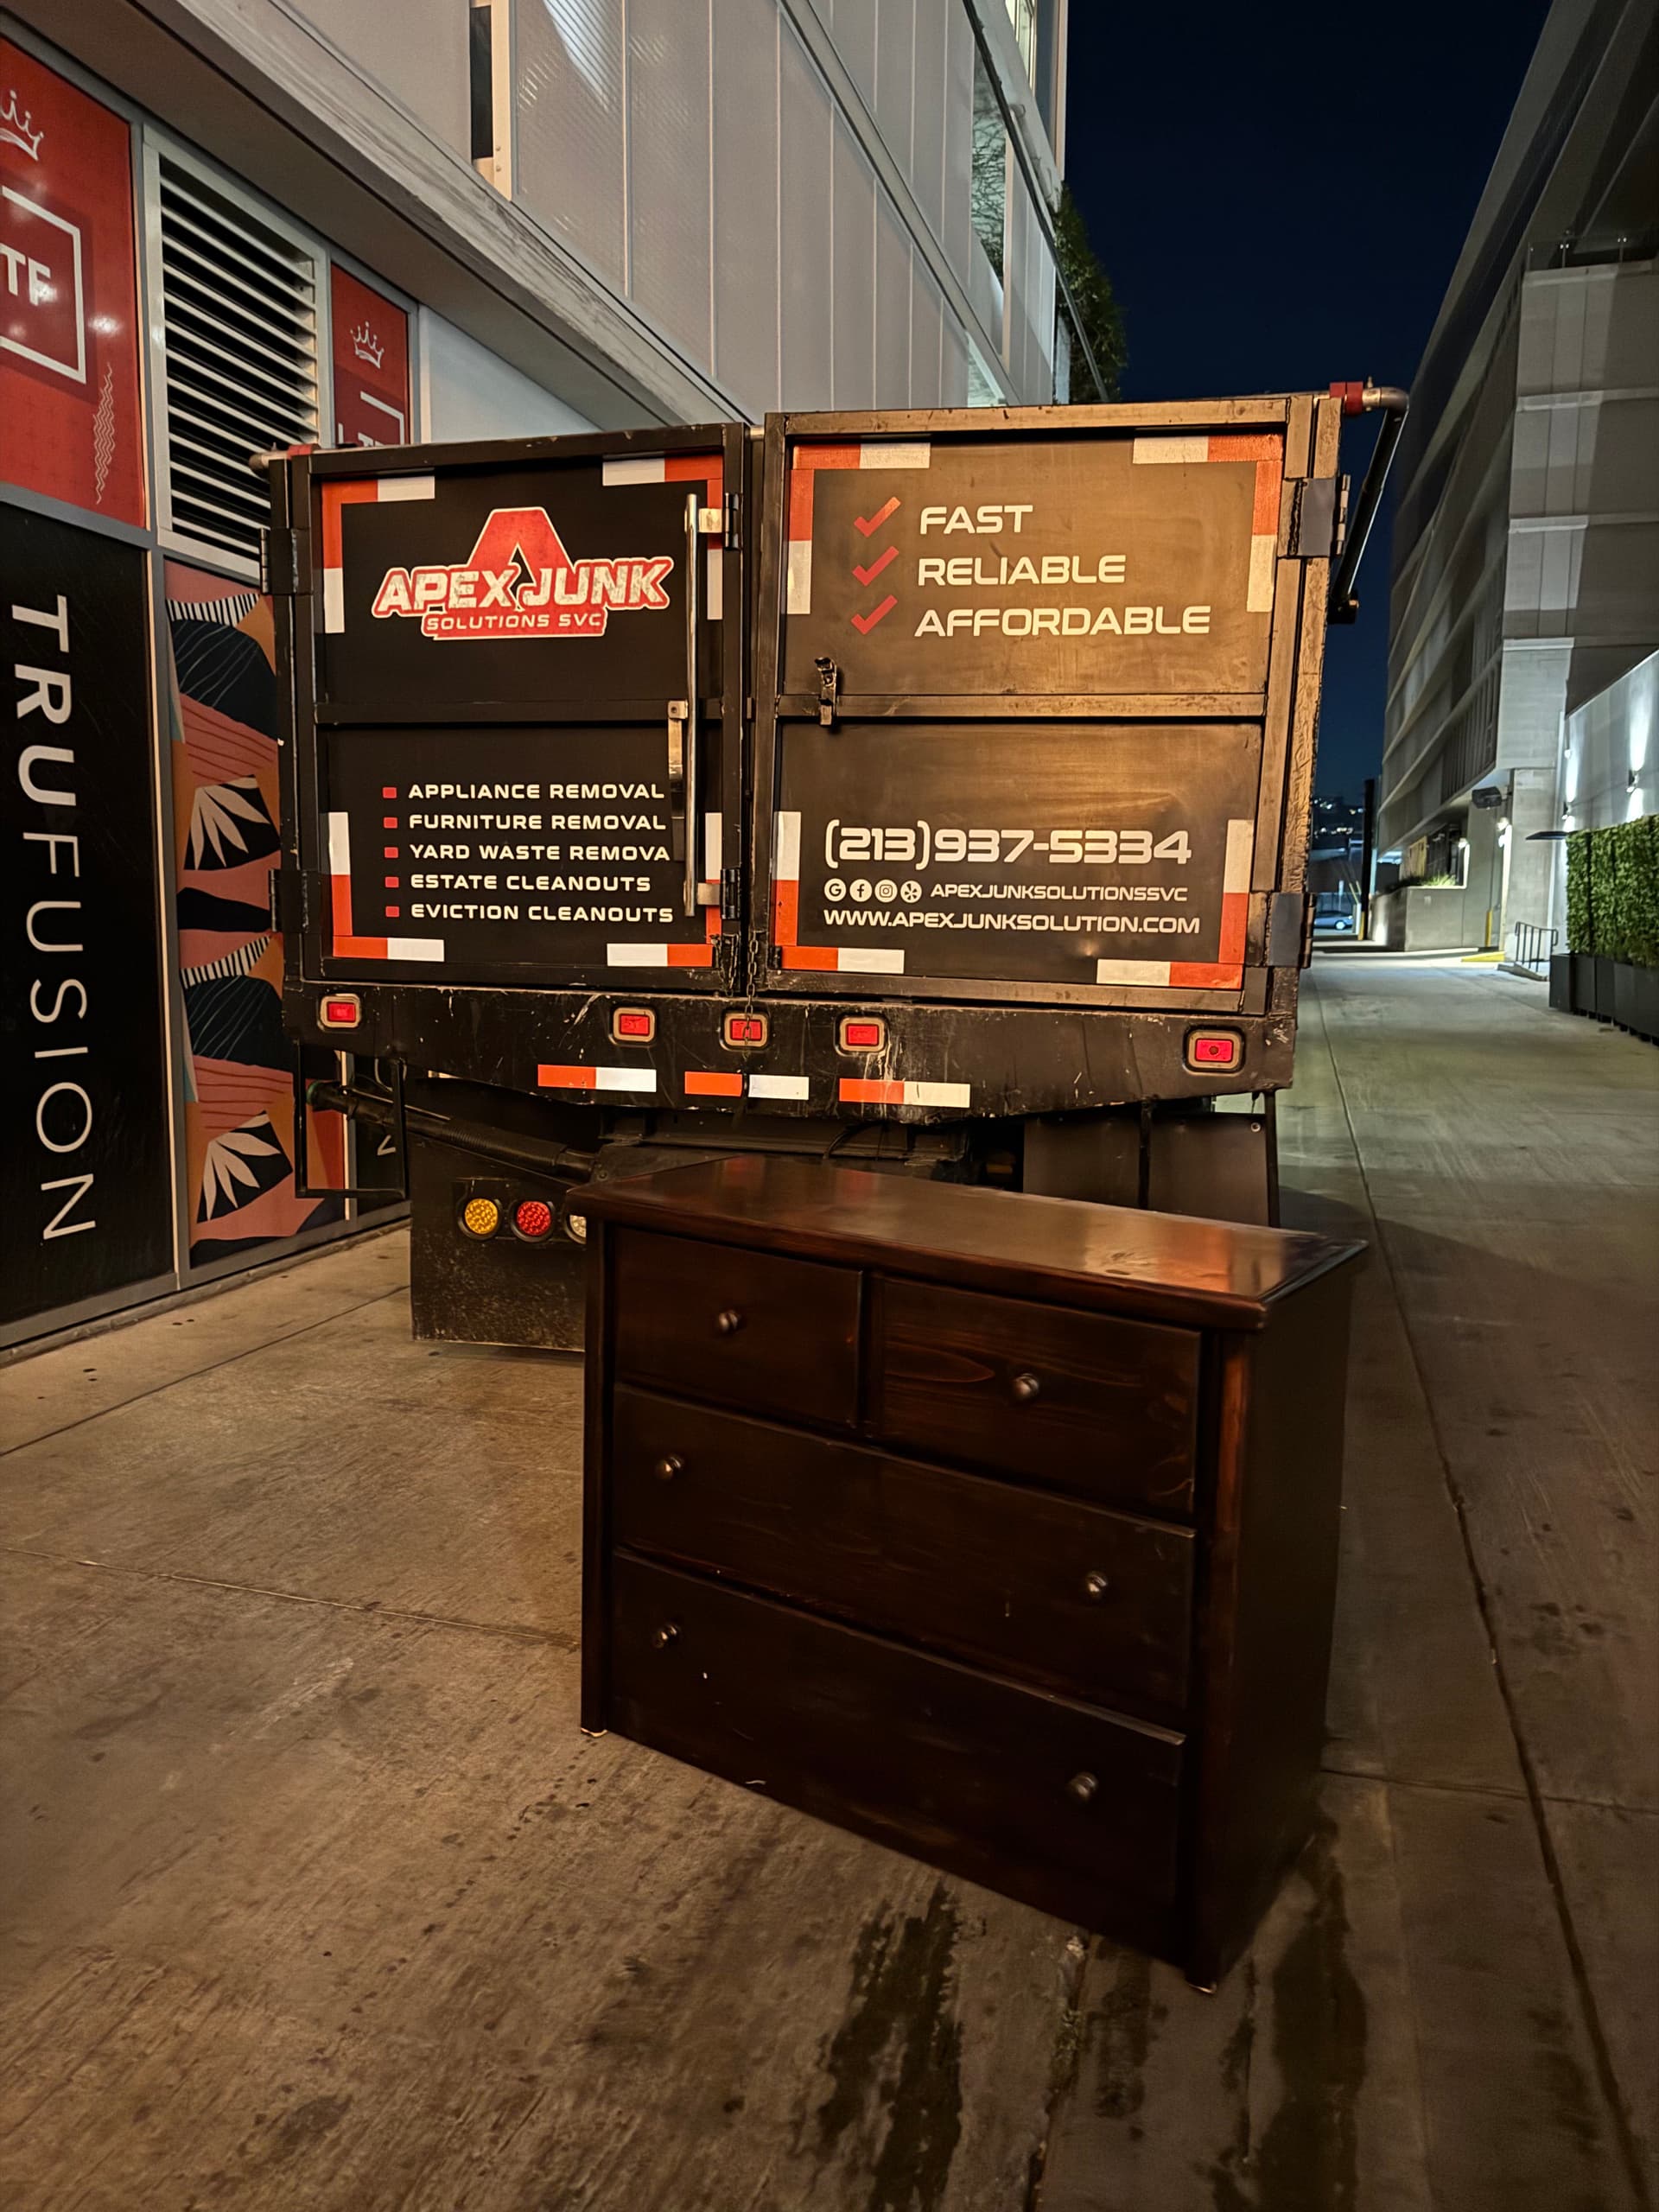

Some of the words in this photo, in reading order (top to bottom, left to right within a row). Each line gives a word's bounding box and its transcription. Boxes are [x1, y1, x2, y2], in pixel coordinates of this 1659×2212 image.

[918, 504, 1034, 535] FAST
[917, 554, 1127, 587] RELIABLE
[375, 567, 517, 613] APEX
[521, 562, 671, 607] JUNK
[426, 613, 550, 632] SOLUTIONS
[557, 612, 603, 627] SVC
[913, 605, 1211, 638] AFFORDABLE
[408, 784, 541, 799] APPLIANCE
[549, 784, 664, 799] REMOVAL
[409, 814, 543, 830] FURNITURE
[551, 814, 666, 830] REMOVAL
[410, 844, 470, 860] YARD
[479, 844, 561, 861] WASTE
[569, 845, 671, 861] REMOVA
[824, 818, 1192, 871] (213)937-5334
[410, 874, 498, 890] ESTATE
[506, 875, 652, 892] CLEANOUTS
[930, 883, 1189, 902] APEXJUNKSOLUTIONSSVC
[10, 593, 97, 1242] TRUFUSION
[410, 904, 519, 920] EVICTION
[528, 906, 673, 923] CLEANOUTS
[823, 909, 1201, 934] WWW.APEXJUNKSOLUTION.COM
